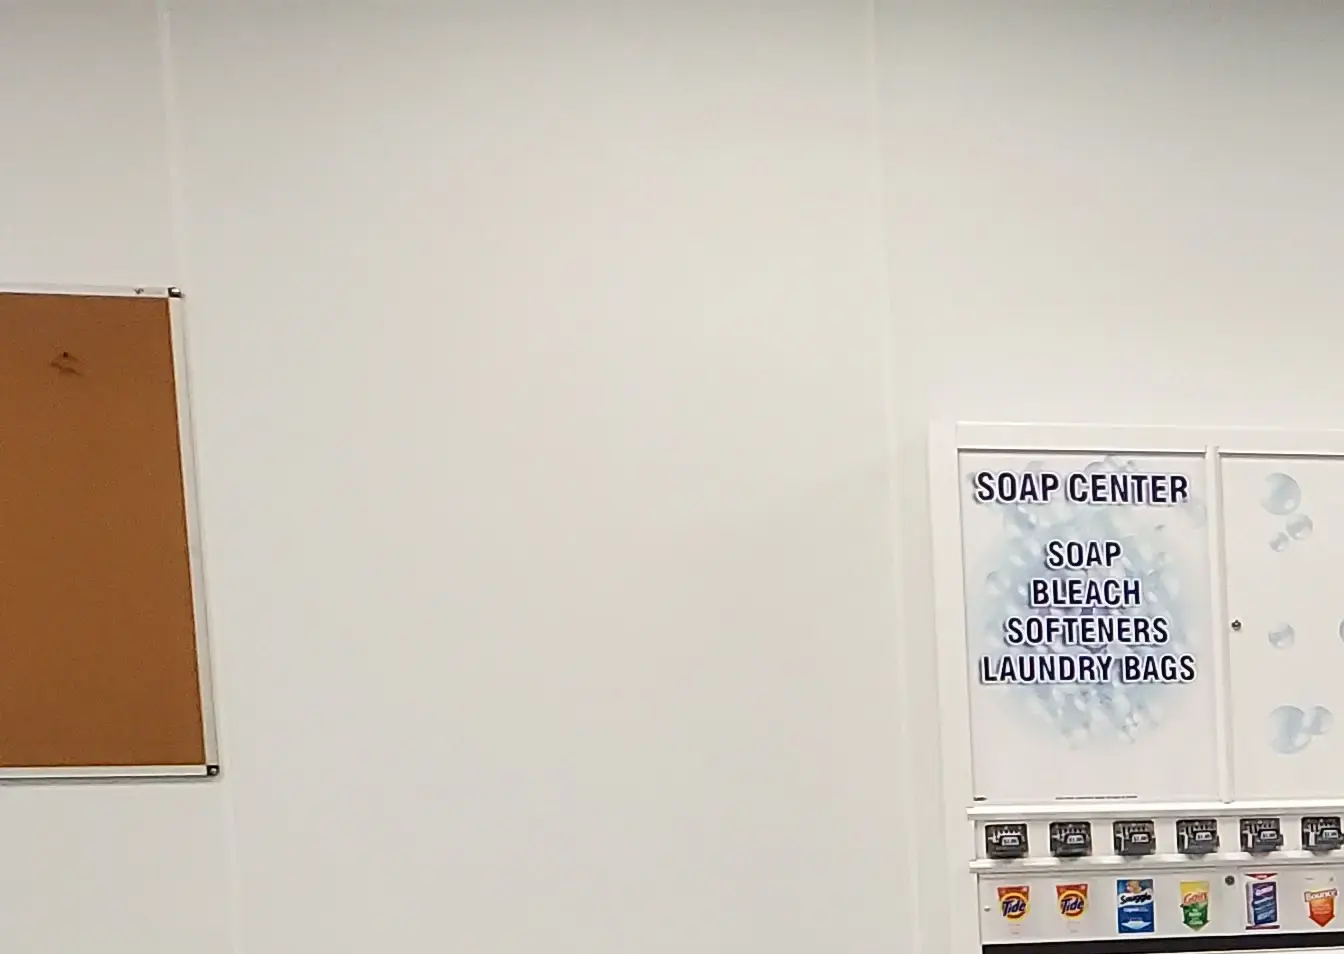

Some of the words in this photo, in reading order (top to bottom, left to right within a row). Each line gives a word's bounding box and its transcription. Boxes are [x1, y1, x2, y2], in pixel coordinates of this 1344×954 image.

[976, 471, 1059, 502] SOAP
[1067, 473, 1189, 503] CENTER
[1047, 540, 1122, 568] SOAP
[1031, 578, 1141, 606] BLEACH
[1007, 616, 1169, 644] SOFTENERS
[982, 655, 1113, 682] LAUNDRY
[1123, 655, 1196, 682] BAGS
[1001, 901, 1026, 917] Tide
[1060, 899, 1085, 914] Tide
[1120, 892, 1152, 905] Snuggle
[1183, 891, 1208, 905] Gain
